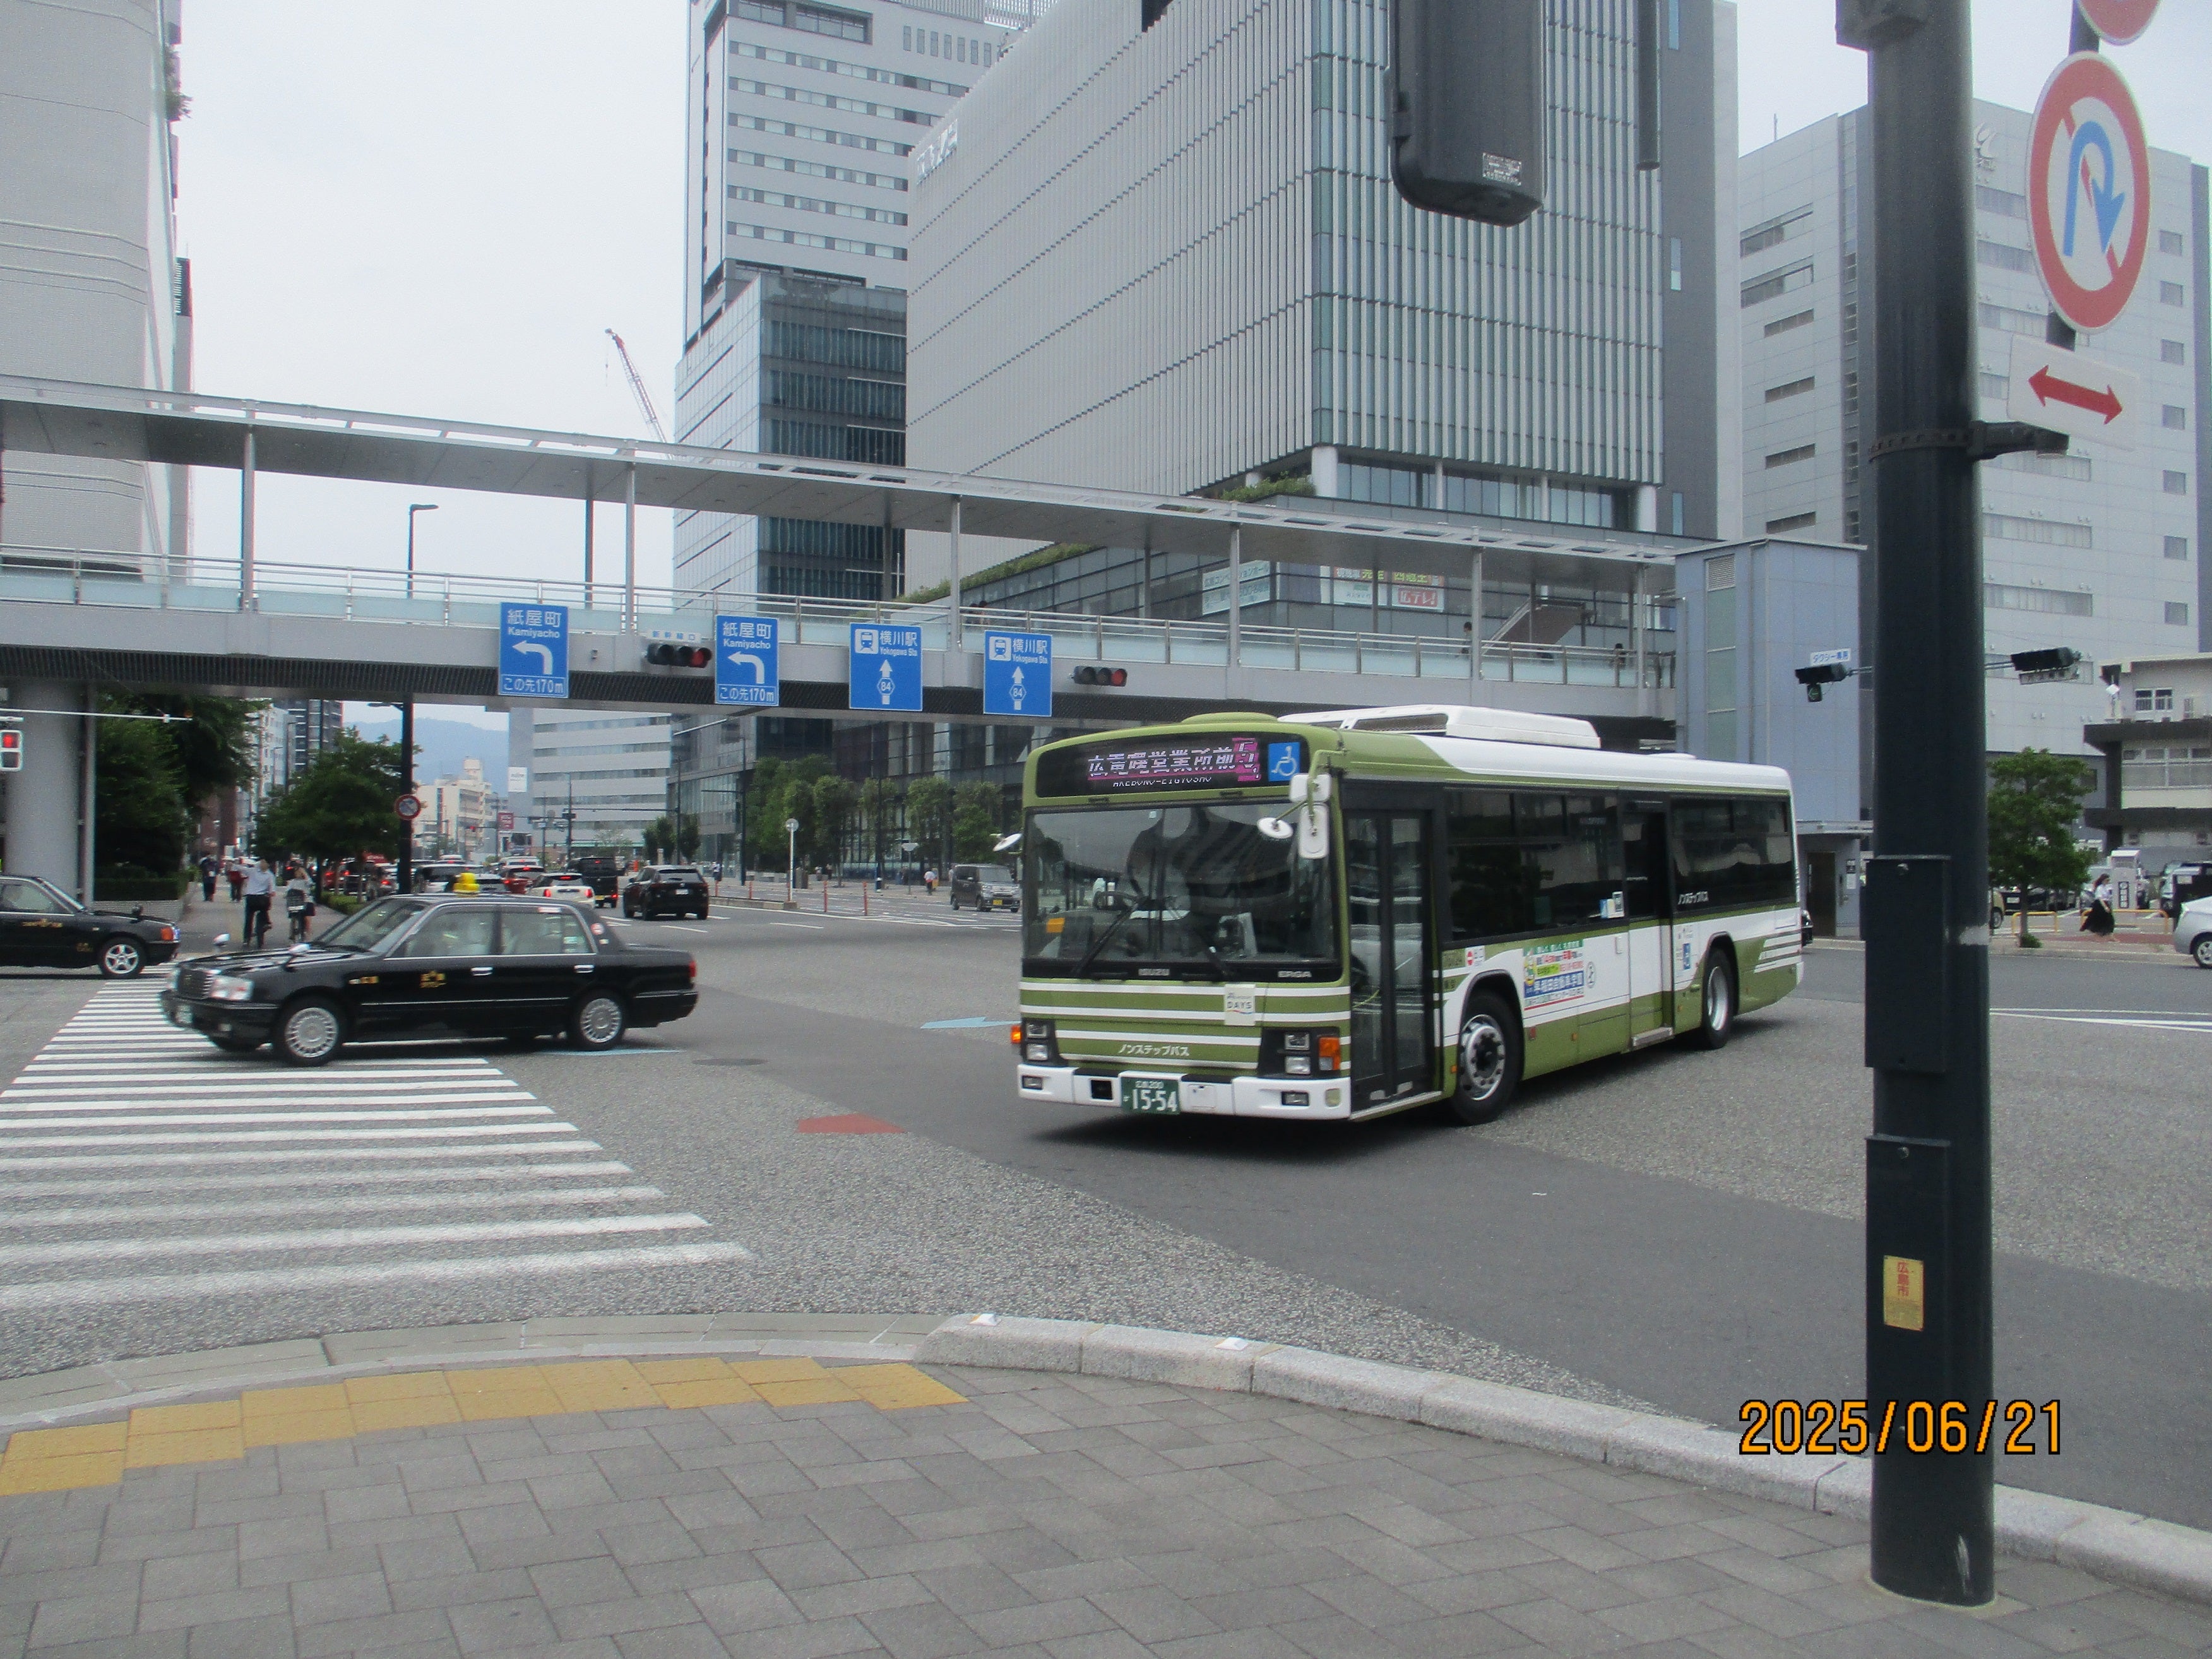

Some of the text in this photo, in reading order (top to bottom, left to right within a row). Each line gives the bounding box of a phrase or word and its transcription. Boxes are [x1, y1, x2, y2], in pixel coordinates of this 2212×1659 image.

[508, 609, 561, 628] 紙屋町
[508, 627, 560, 639] Kamiyacho
[723, 621, 772, 639] 紙屋町
[879, 629, 918, 647] 横川駅
[723, 638, 771, 650] Kamiyacho
[879, 646, 907, 657] Yokogawa
[1012, 638, 1047, 655] 横川駅
[1012, 653, 1038, 664] Yokogawa
[504, 677, 564, 694] この先170m
[880, 681, 891, 691] 84
[1013, 687, 1023, 698] 84
[720, 686, 775, 703] この先170m
[1119, 1044, 1190, 1057] ノンステップバス
[1132, 1089, 1178, 1112] 15-54
[1897, 1261, 1910, 1297] 広島市
